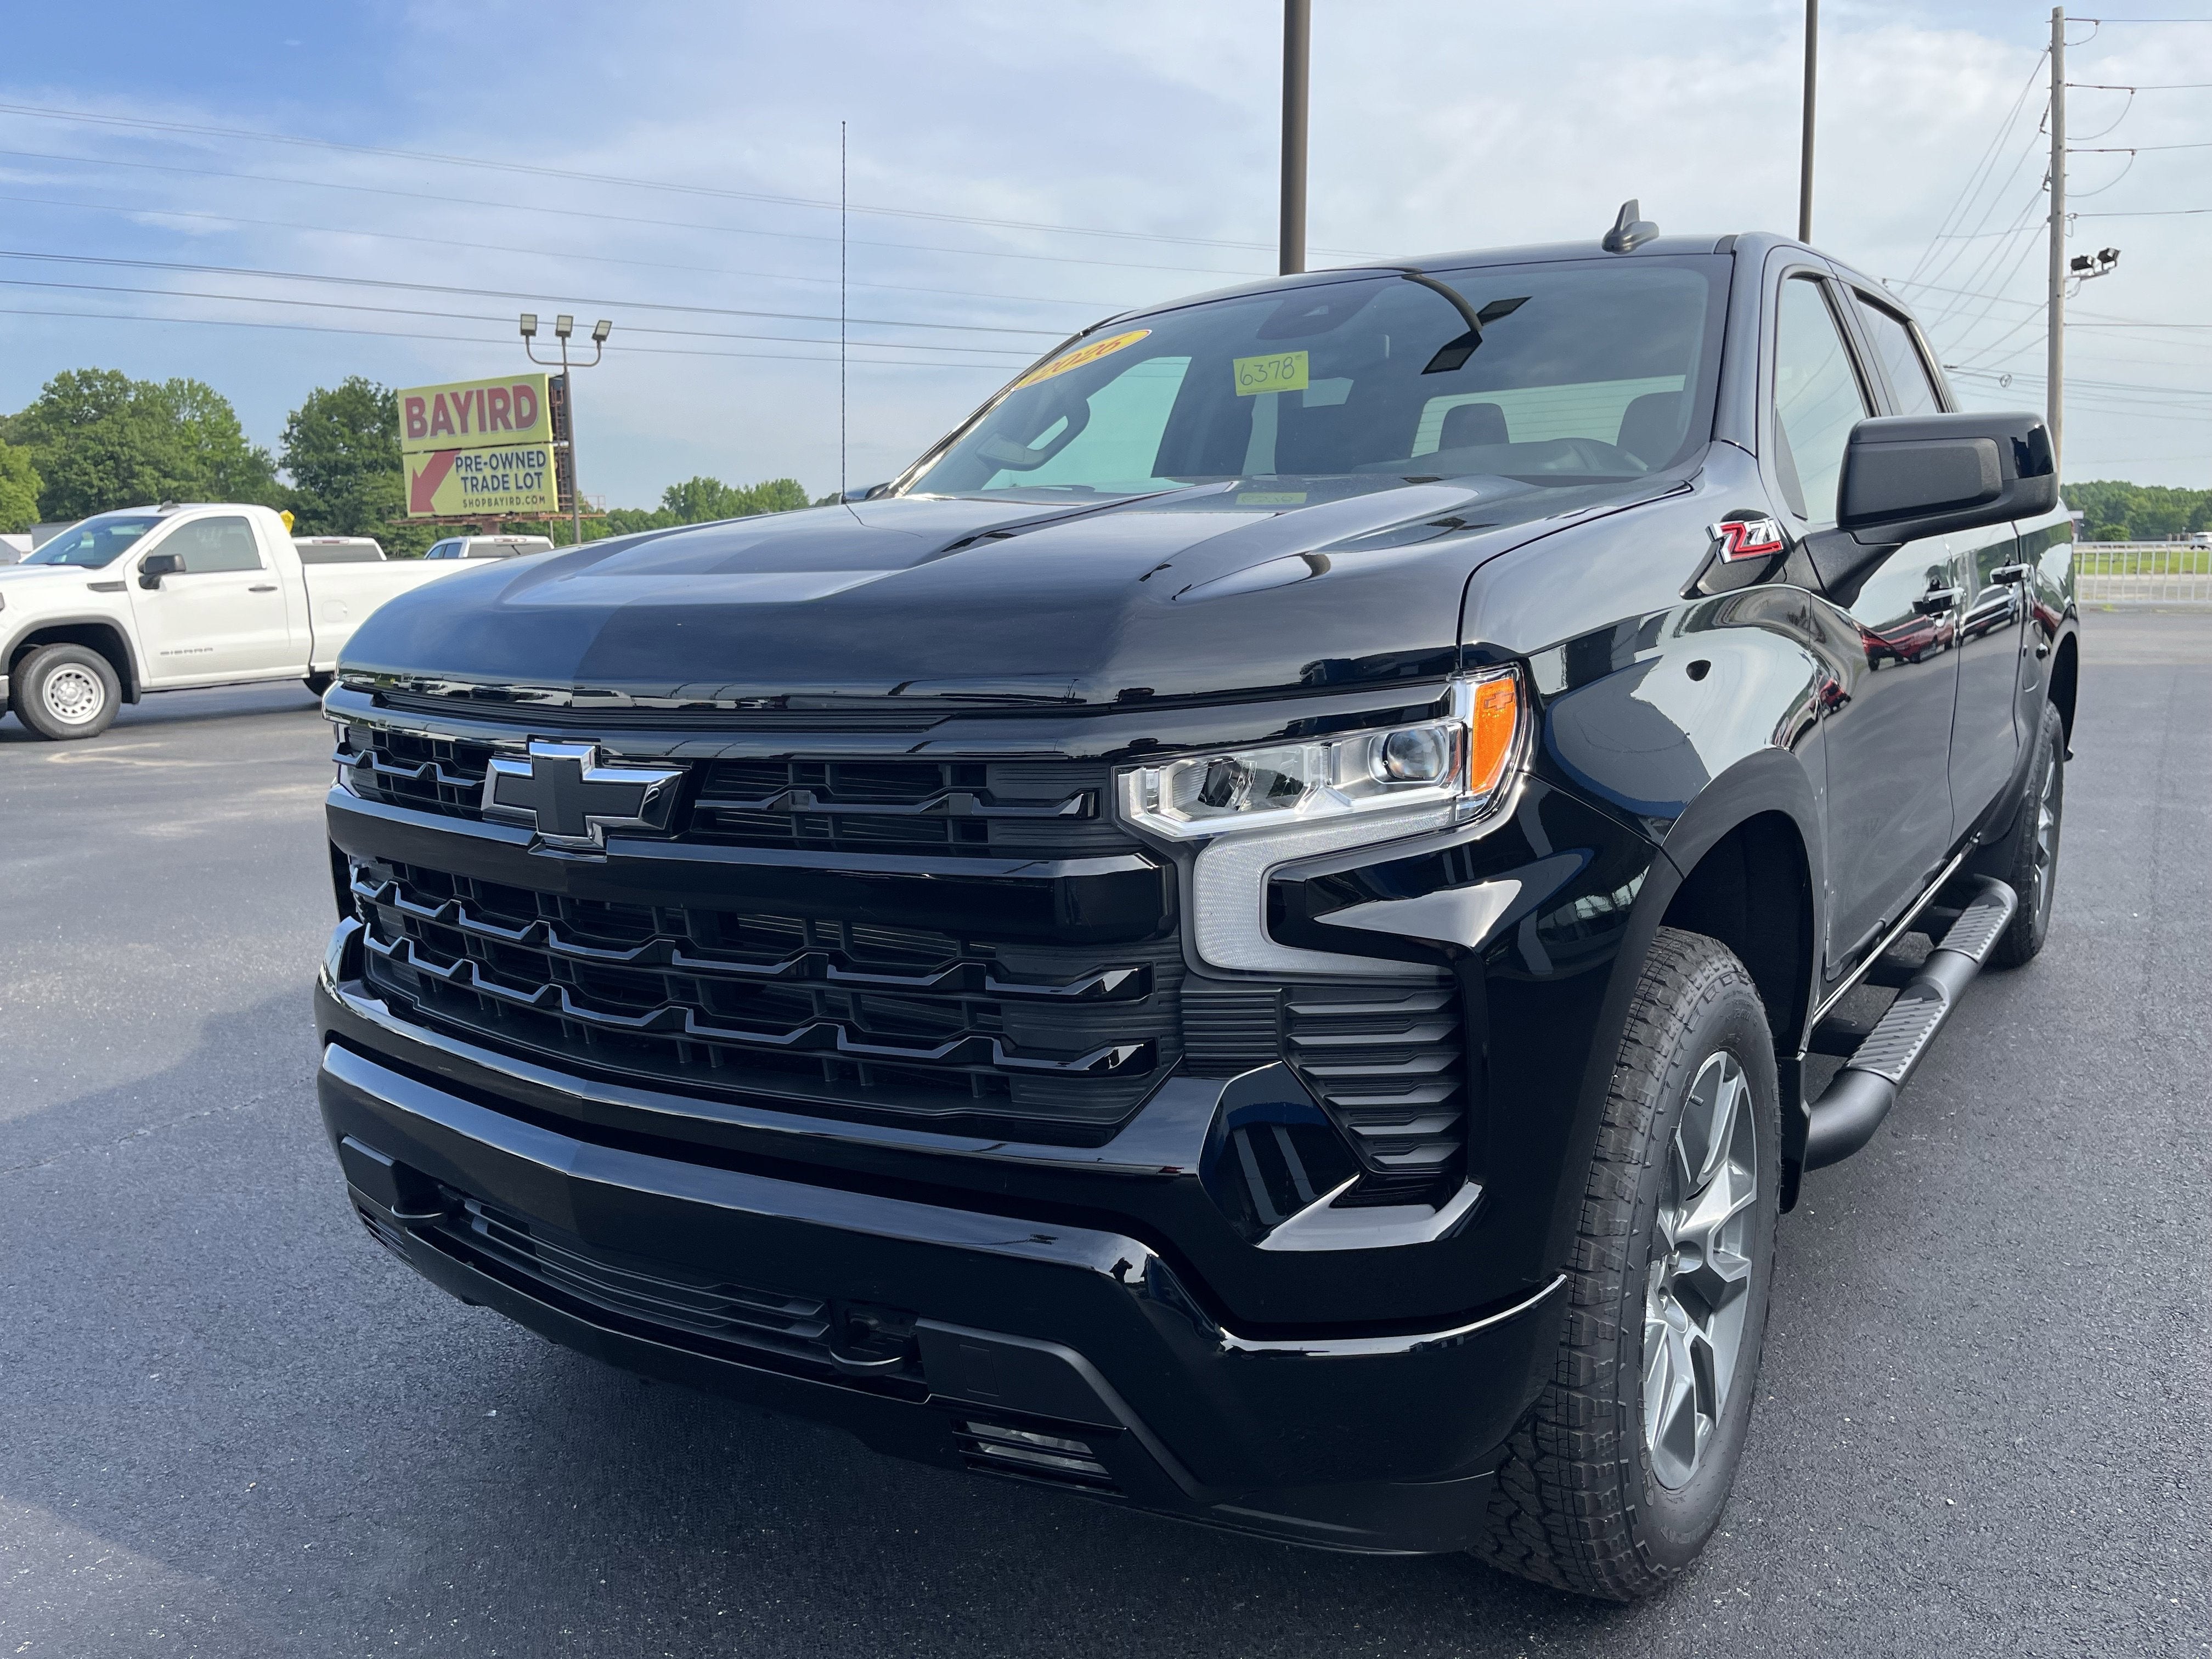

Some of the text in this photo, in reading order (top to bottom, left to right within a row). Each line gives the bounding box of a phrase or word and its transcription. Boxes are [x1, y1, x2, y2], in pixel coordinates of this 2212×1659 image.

[1240, 357, 1295, 386] 6378
[405, 385, 538, 439] BAYIRD
[455, 450, 546, 473] PRE-OWNED
[461, 472, 543, 493] TRADE LOT
[462, 495, 546, 509] SHOPBAYIRD.COM
[1706, 517, 1784, 565] Z71
